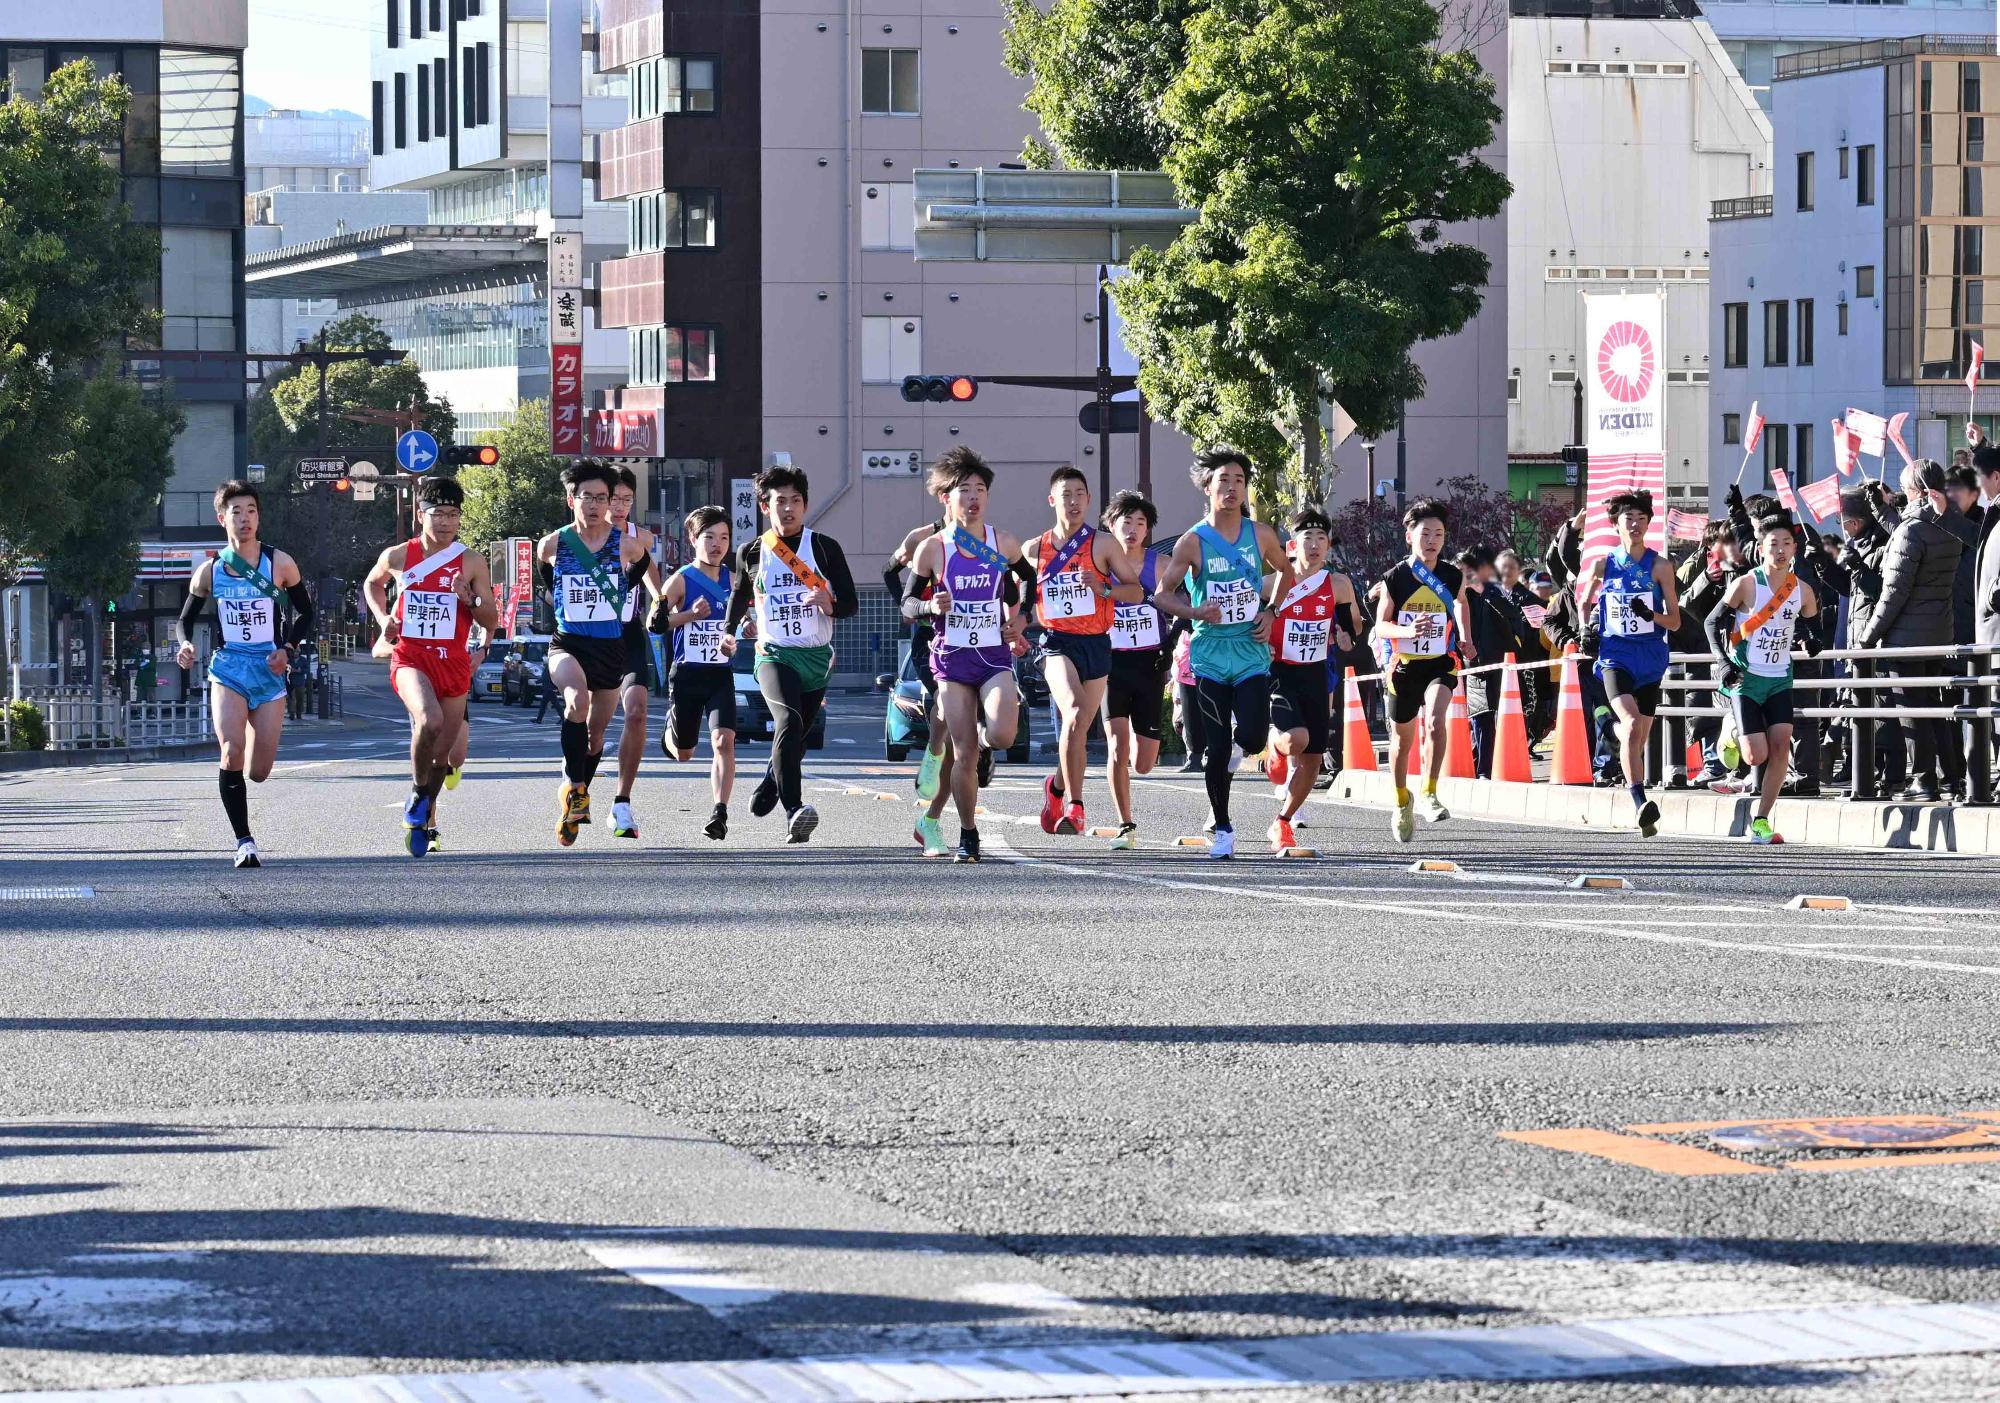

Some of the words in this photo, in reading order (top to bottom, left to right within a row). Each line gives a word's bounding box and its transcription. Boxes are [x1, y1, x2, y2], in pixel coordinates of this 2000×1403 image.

[554, 236, 567, 245] 4F
[556, 353, 578, 444] カラオケ
[301, 461, 345, 472] 防災新館東
[518, 547, 530, 595] 中華そば
[570, 576, 598, 587] NE
[954, 573, 991, 590] 南アルプス
[1047, 572, 1082, 585] NEC
[1047, 584, 1088, 602] 甲州市
[1214, 580, 1252, 594] NEC
[225, 600, 264, 611] NEC
[410, 592, 449, 605] NEC
[770, 592, 809, 606] NEC
[408, 604, 451, 621] 甲斐市A
[586, 605, 596, 619] 7
[769, 605, 813, 622] 上野原市
[953, 602, 994, 614] NEC
[1063, 601, 1073, 616] 3
[1114, 605, 1150, 618] NEC
[1226, 607, 1246, 623] 15
[226, 611, 266, 627] 山梨市
[948, 613, 998, 630] 南アルプス市A
[1113, 617, 1152, 633] 甲府市
[1404, 613, 1440, 625] NC
[418, 622, 436, 637] 11
[691, 621, 724, 632] NEC
[782, 621, 802, 637] 18
[1291, 621, 1326, 633] NEC
[1621, 620, 1639, 633] 13
[1760, 626, 1790, 638] NEC
[242, 628, 251, 641] 5
[689, 632, 723, 647] 笛吹市
[968, 631, 979, 646] 8
[1130, 633, 1137, 646] 1
[1288, 632, 1327, 647] 甲斐市B
[1412, 640, 1430, 654] 14
[1756, 637, 1788, 651] 北杜市
[700, 648, 718, 662] 12
[1299, 647, 1317, 661] 17
[1765, 651, 1780, 664] 10
